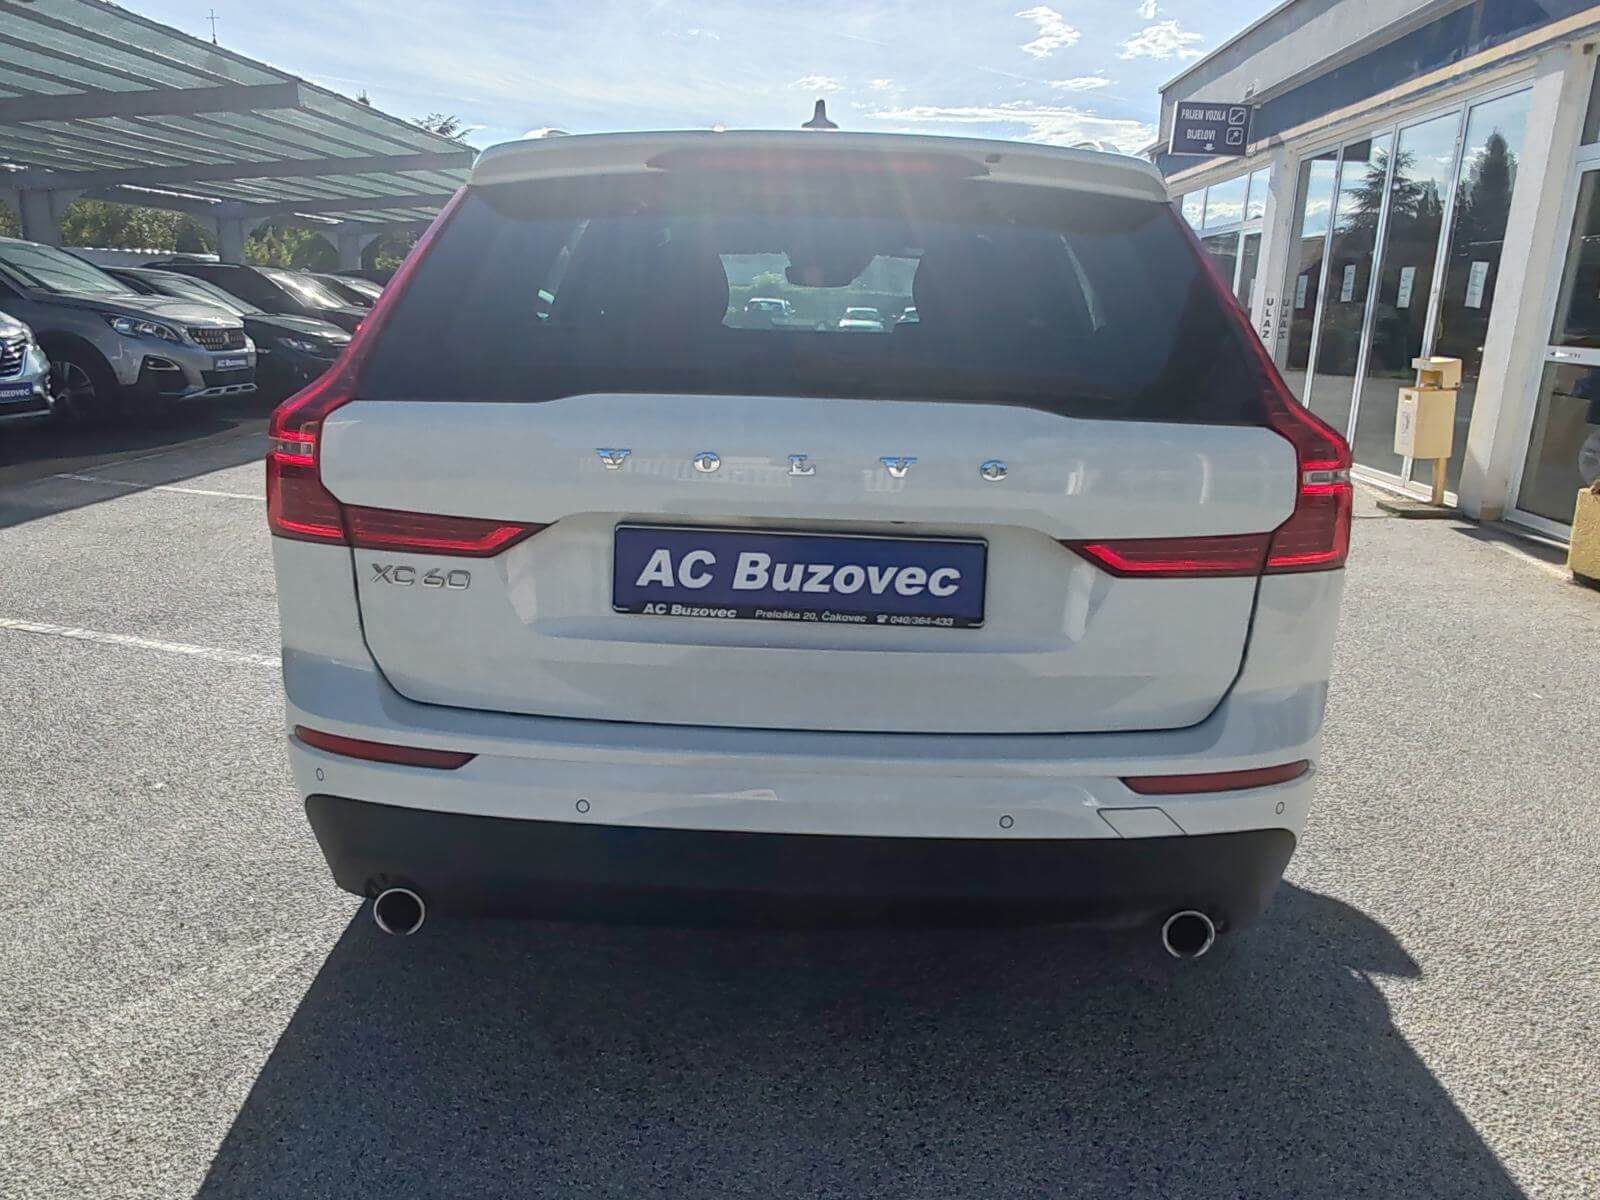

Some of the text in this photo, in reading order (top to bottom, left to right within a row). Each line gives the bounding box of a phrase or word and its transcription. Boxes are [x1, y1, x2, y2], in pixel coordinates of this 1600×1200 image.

[1205, 109, 1226, 121] VOZILA
[1262, 297, 1274, 339] ULAZ
[596, 447, 1009, 482] VOLVO
[635, 548, 961, 597] AC Buzovec
[643, 602, 667, 615] AC
[670, 603, 737, 619] Buzovec
[802, 611, 819, 622] 20,
[821, 610, 868, 624] Čakovec
